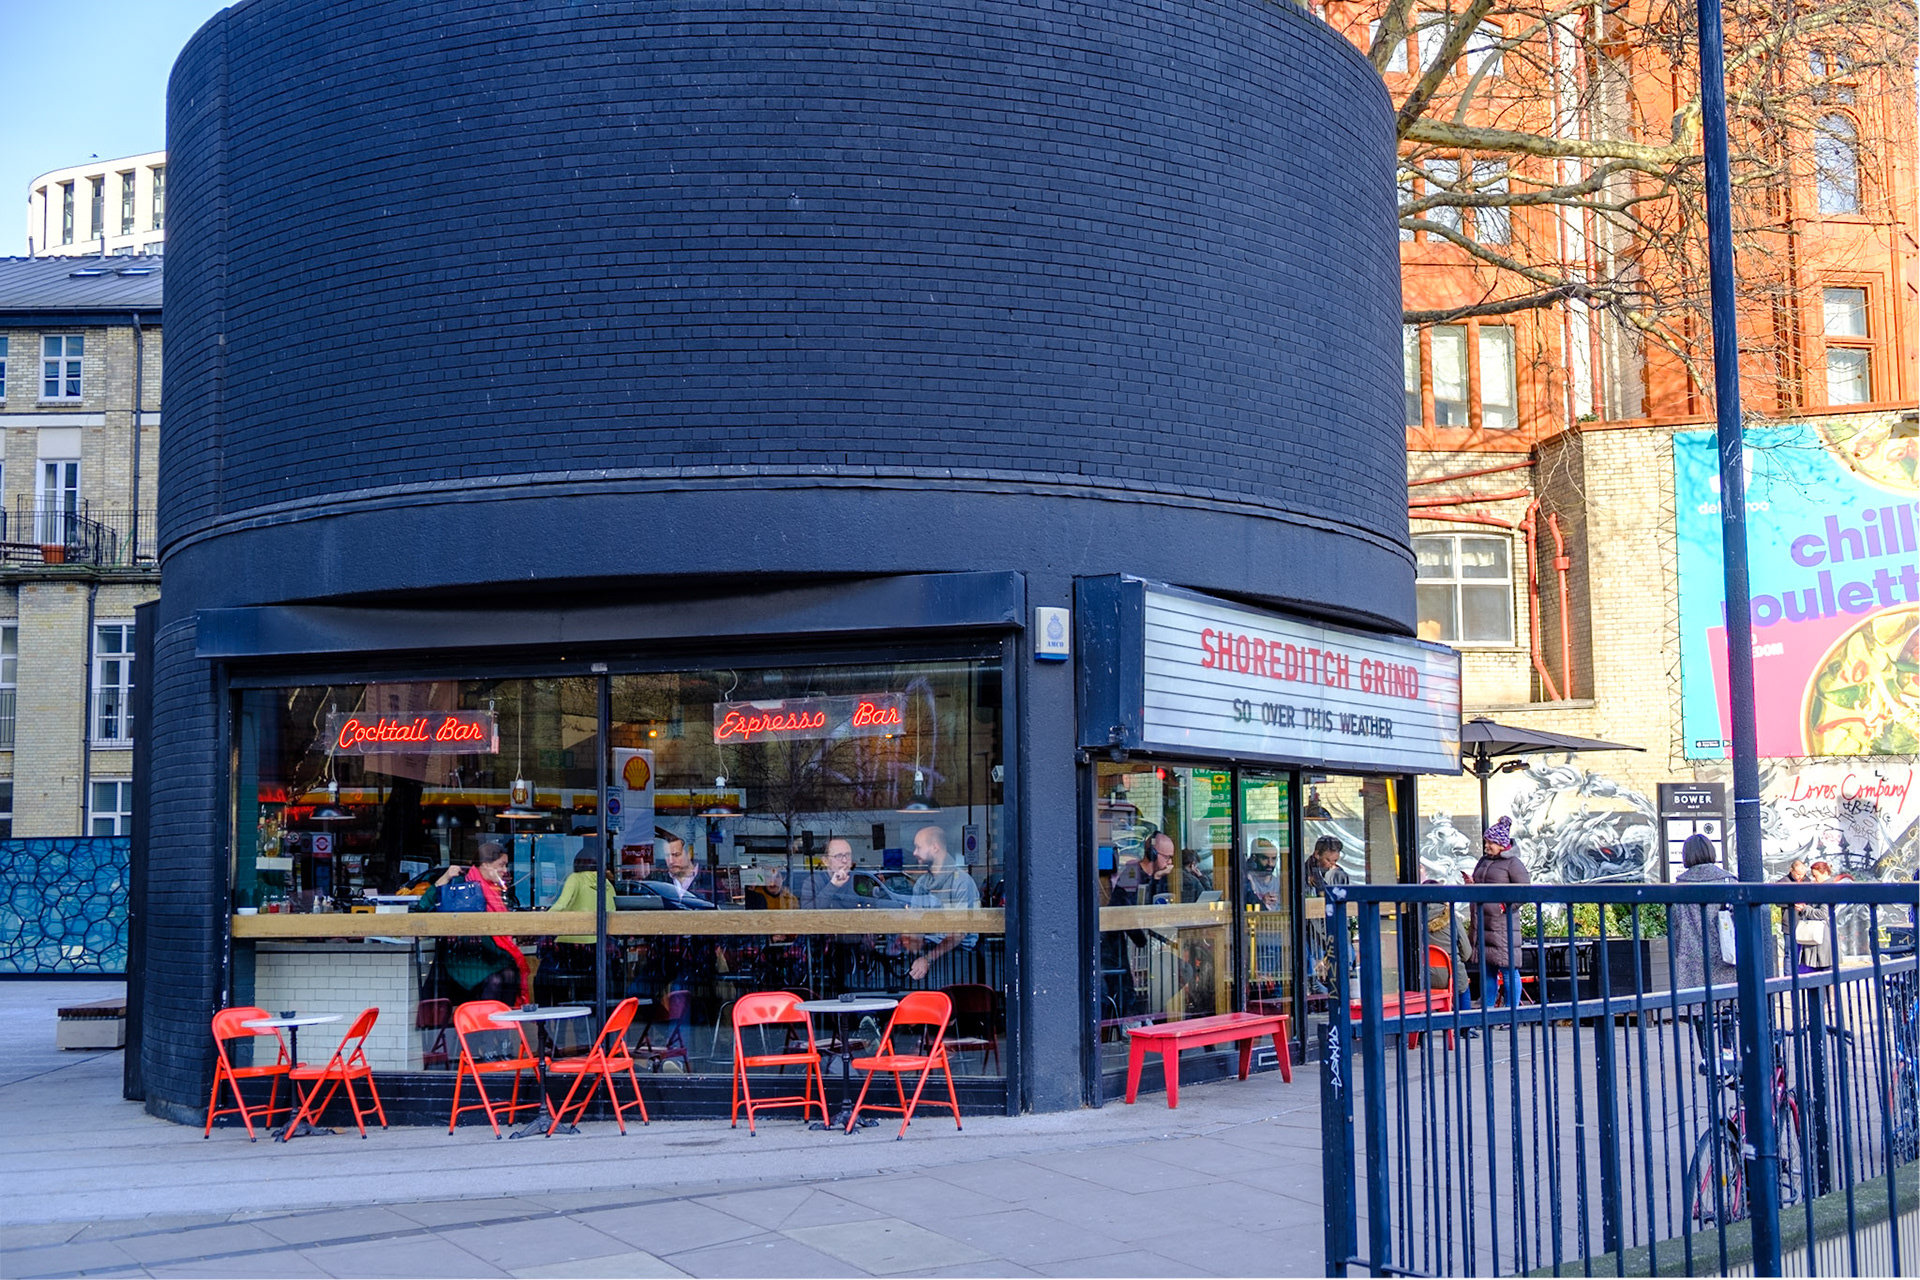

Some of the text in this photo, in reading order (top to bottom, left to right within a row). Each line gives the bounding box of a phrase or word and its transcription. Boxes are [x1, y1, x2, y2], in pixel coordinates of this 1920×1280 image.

[1698, 500, 1769, 514] delroo
[1720, 564, 1919, 628] oulett
[1201, 628, 1419, 700] SHOREDITCH GRIND
[338, 716, 483, 749] Cocktail Bar
[715, 701, 902, 740] Espresso Bar
[1233, 698, 1393, 739] SO OVER THIS WEATHER
[1673, 795, 1712, 804] BOWER
